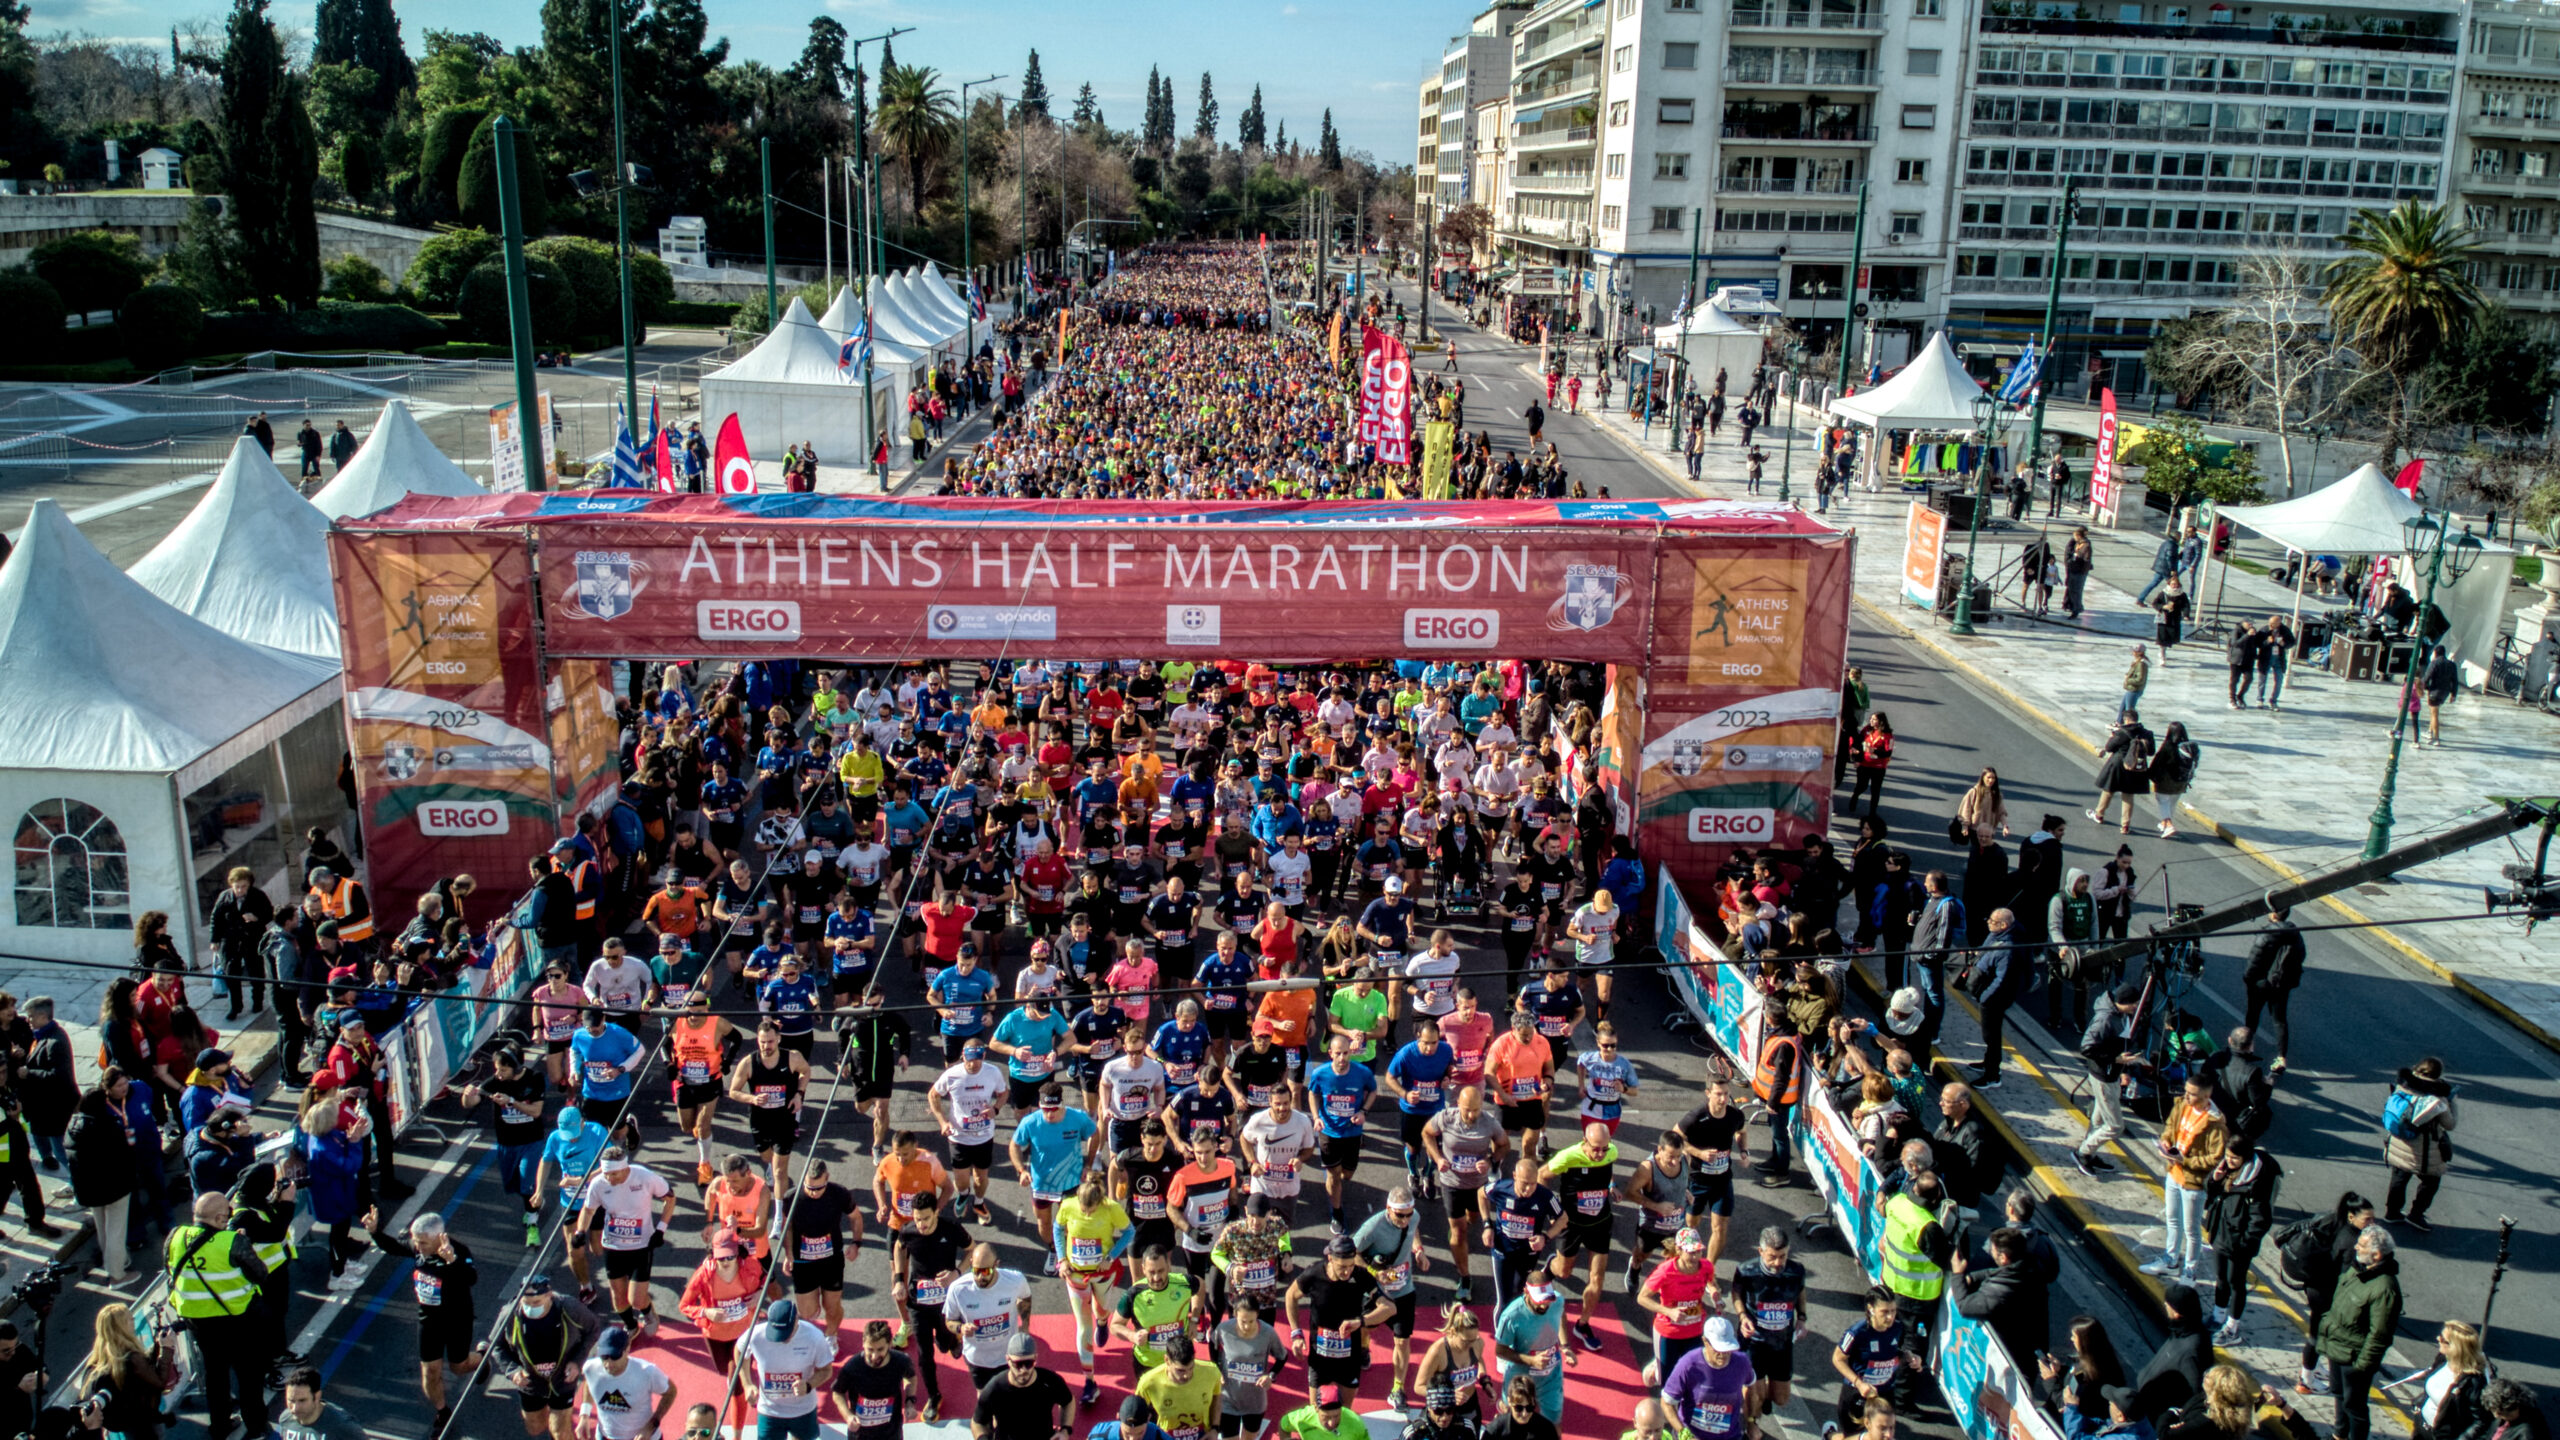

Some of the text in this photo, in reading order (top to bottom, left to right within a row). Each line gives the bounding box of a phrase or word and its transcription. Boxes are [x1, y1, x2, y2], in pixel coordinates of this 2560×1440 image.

[1378, 359, 1408, 463] ERGO
[2092, 411, 2117, 506] ERGO
[576, 551, 631, 564] SEGAS
[679, 535, 1529, 593] ATHENS HALF MARATHON
[1566, 564, 1618, 577] SEGAS
[427, 594, 481, 607] ΑΘΗΝΑΣ
[1736, 598, 1789, 611] ATHENS
[709, 608, 790, 632] ERGO
[1739, 615, 1783, 630] HALF
[1415, 617, 1490, 640] ERGO
[1735, 634, 1784, 644] MARATHON
[426, 662, 467, 675] ERGO
[1721, 663, 1763, 677] ERGO
[427, 709, 481, 729] 2023
[1717, 709, 1771, 729] 2023
[1673, 738, 1703, 746] SEGAS
[428, 807, 499, 829] ERGO
[1697, 814, 1766, 834] ERGO
[1516, 1076, 1535, 1084] ERGO
[760, 1085, 782, 1093] ERGO
[1138, 1195, 1159, 1203] ERGO
[1583, 1191, 1604, 1199] ERGO
[1203, 1202, 1224, 1213] ERGO
[614, 1218, 637, 1227] ERGO
[1505, 1213, 1529, 1223] ERGO
[614, 1226, 636, 1235] 4703
[804, 1236, 827, 1245] ERGO
[1075, 1238, 1096, 1246] ERGO
[805, 1243, 827, 1252] 3169
[1247, 1260, 1270, 1269] ERGO
[1248, 1268, 1270, 1279] 3118
[417, 1273, 438, 1285] ERGO
[717, 1297, 742, 1307] ERGO
[1763, 1302, 1788, 1310] ERGO
[1764, 1310, 1787, 1320] 4186
[979, 1315, 1004, 1326] ERGO
[980, 1323, 1004, 1334] 4867
[1155, 1322, 1180, 1332] ERGO
[1235, 1362, 1258, 1372] 3084
[1873, 1359, 1895, 1368] ERGO
[769, 1373, 795, 1382] ERGO
[862, 1397, 889, 1406] ERGO
[862, 1406, 887, 1416] 3258
[1701, 1403, 1727, 1412] ERGO
[1173, 1427, 1199, 1436] ERGO
